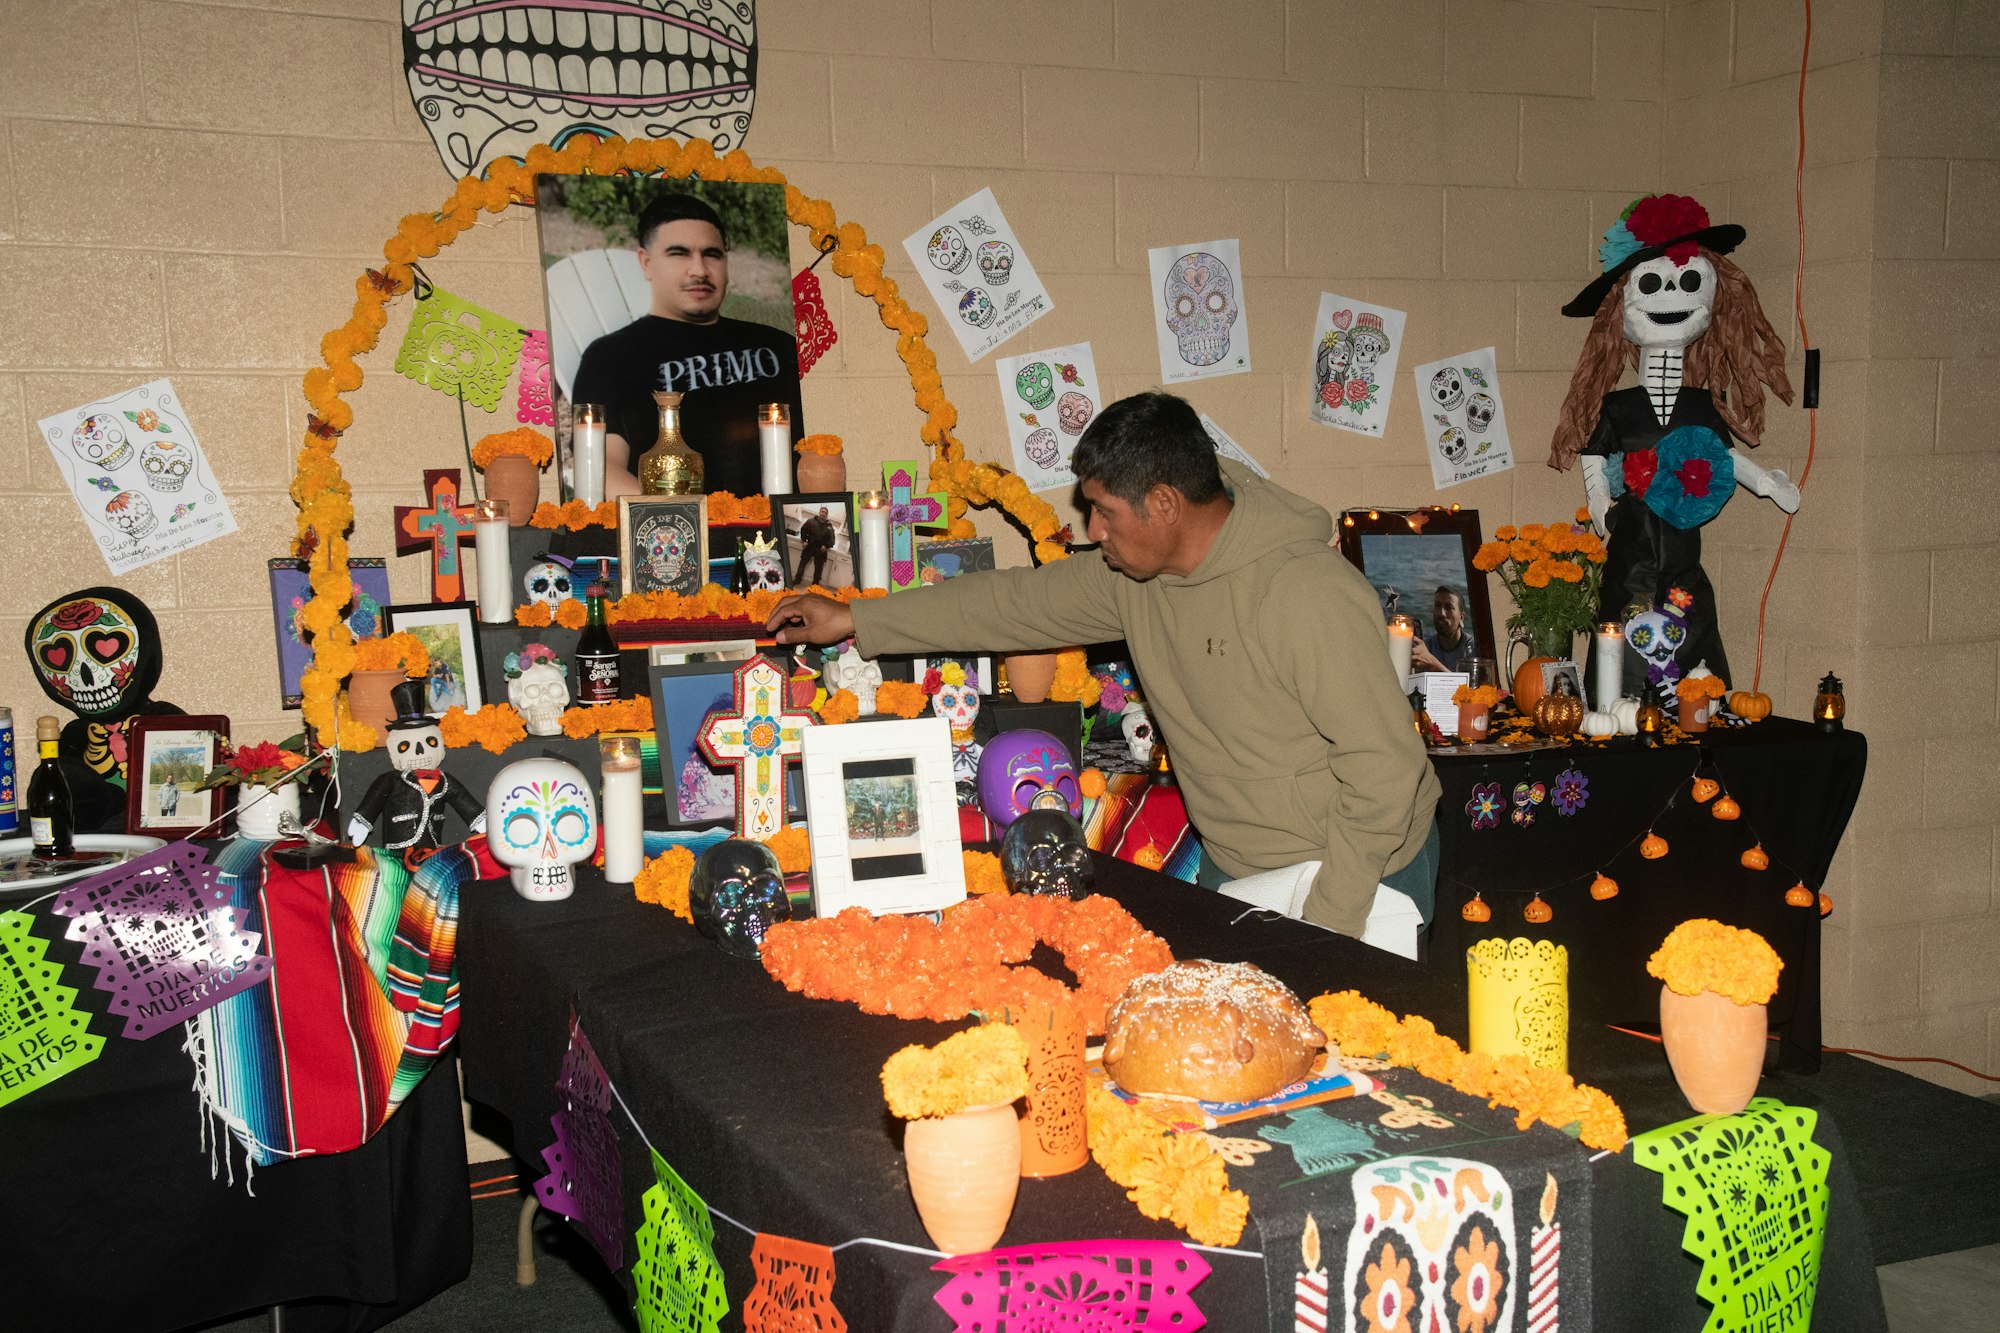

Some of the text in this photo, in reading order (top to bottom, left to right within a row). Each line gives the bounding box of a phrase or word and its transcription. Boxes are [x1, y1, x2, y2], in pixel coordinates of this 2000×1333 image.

[1004, 314, 1012, 322] De
[1012, 308, 1021, 317] Los
[1021, 294, 1042, 310] Muertos
[657, 347, 780, 392] PRIMO
[1479, 456, 1488, 464] Los
[1488, 451, 1508, 461] Muertos
[1454, 465, 1487, 482] Flower
[168, 524, 179, 535] De
[180, 519, 194, 531] Los
[194, 511, 224, 526] Muertos
[657, 514, 672, 523] DE
[674, 516, 692, 535] LOS
[145, 946, 226, 997] DÍA DE
[136, 955, 248, 1019] MUERTOS
[18, 1027, 54, 1057] DE
[0, 1034, 77, 1091] ERTOS
[1785, 1250, 1813, 1293] DE
